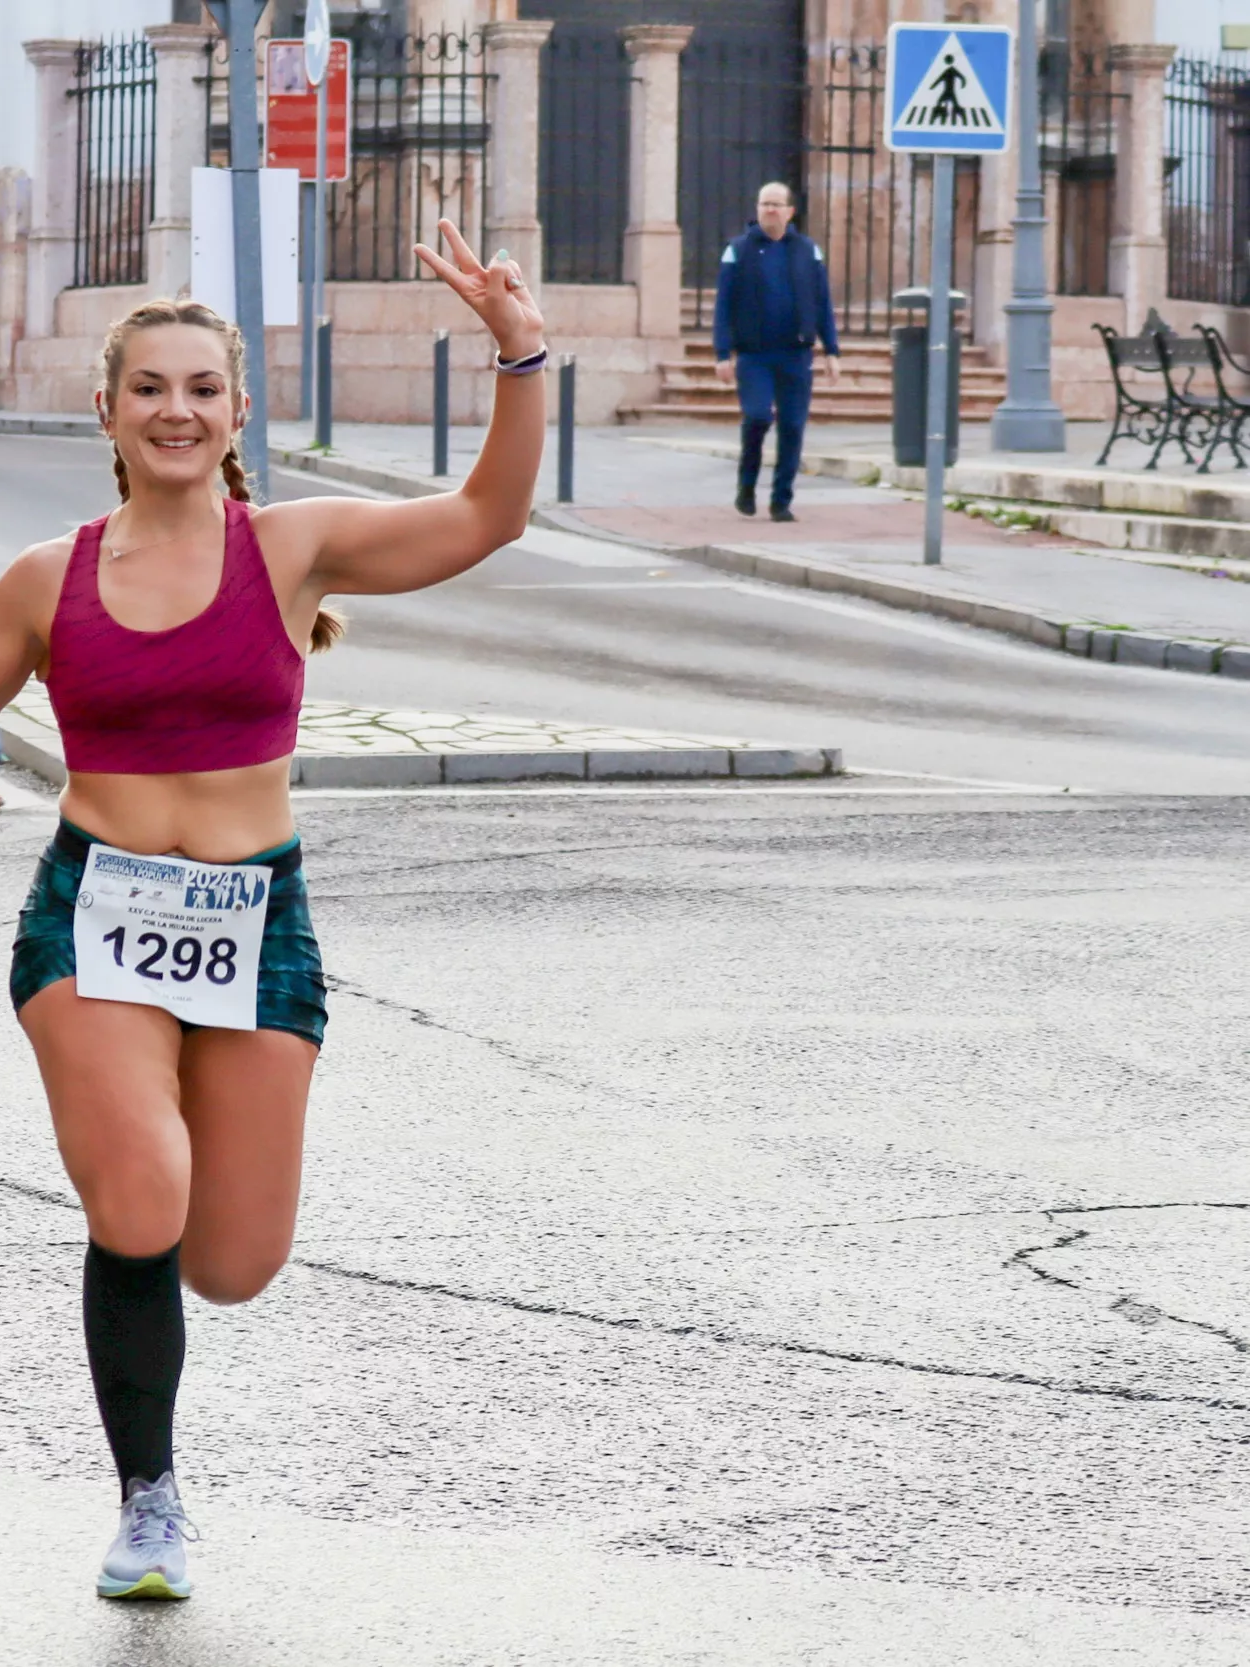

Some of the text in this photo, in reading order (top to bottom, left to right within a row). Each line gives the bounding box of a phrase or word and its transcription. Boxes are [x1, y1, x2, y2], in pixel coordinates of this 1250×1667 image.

[95, 861, 135, 877] CARRERAS
[129, 859, 172, 874] PROVINCIAL
[186, 869, 232, 889] 2024
[128, 906, 144, 915] XXV
[158, 911, 185, 921] CIUDAD
[142, 919, 156, 927] POR
[168, 922, 205, 932] IGUALDAD
[102, 925, 239, 986] 1298
